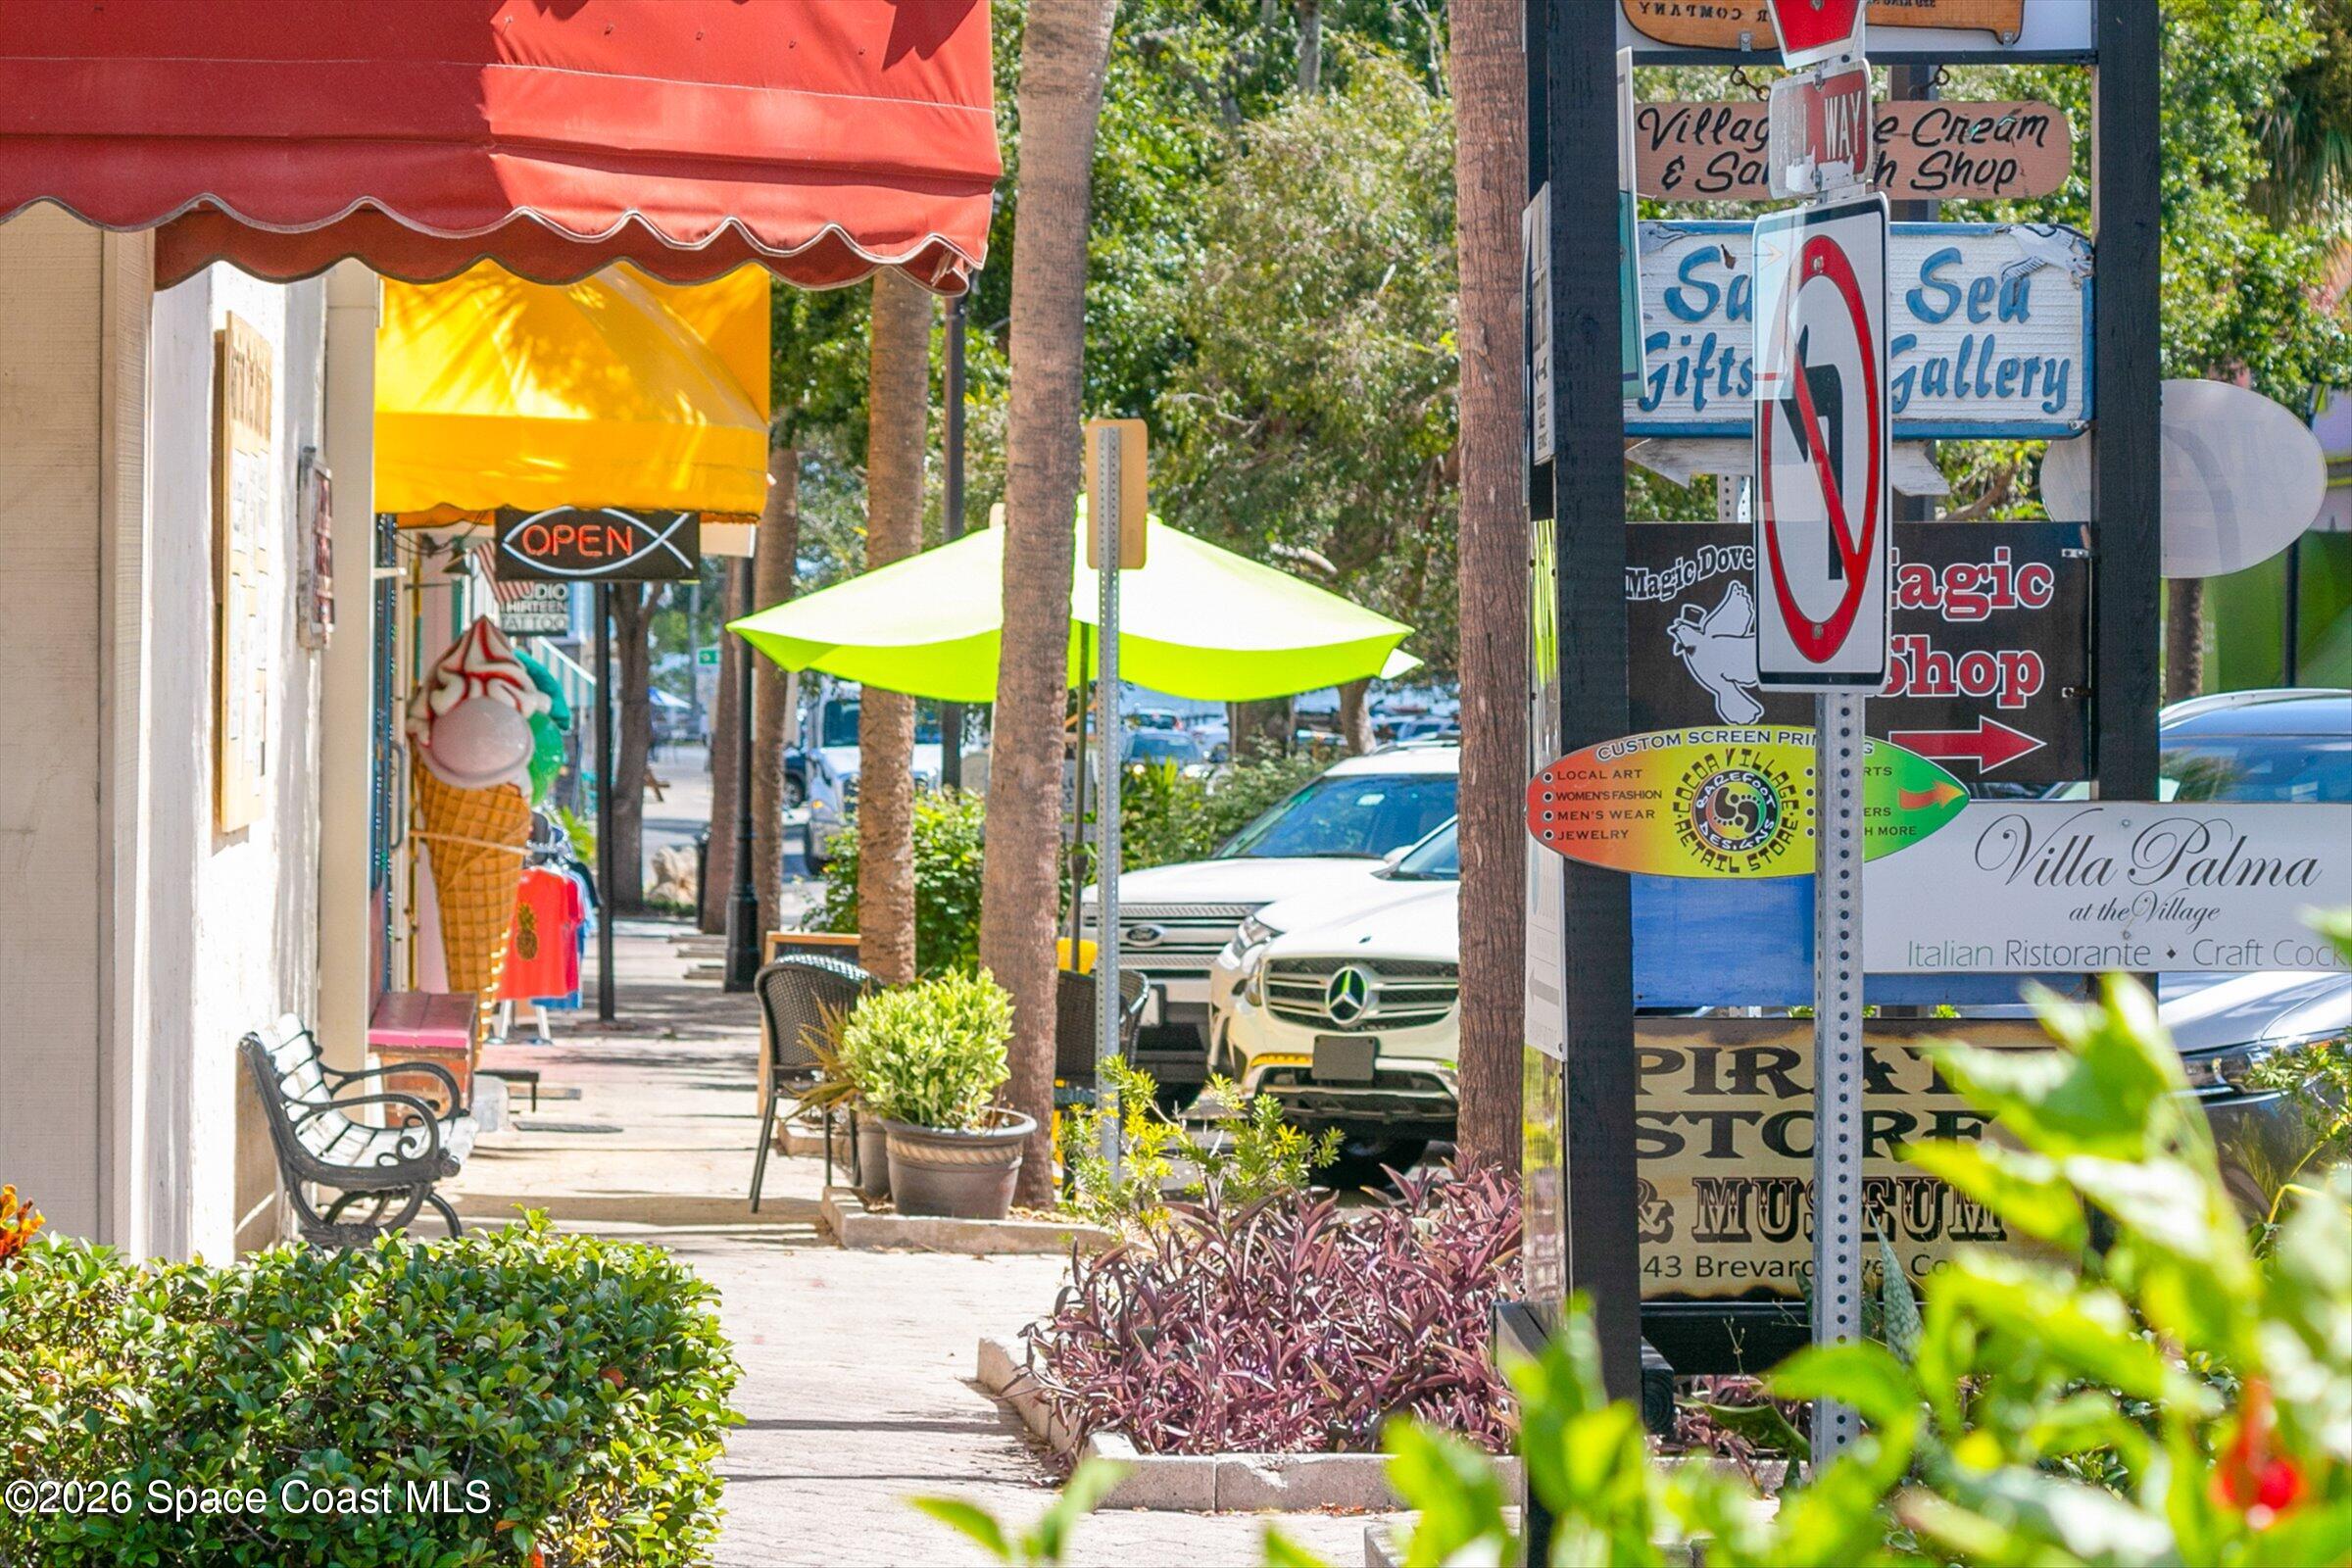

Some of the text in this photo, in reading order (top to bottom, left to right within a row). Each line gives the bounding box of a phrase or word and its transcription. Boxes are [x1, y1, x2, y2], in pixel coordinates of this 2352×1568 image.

[1637, 107, 1770, 153] Villag
[1912, 107, 2049, 147] Cream
[1824, 90, 1862, 160] WAY
[1910, 150, 2017, 194] Shop
[1905, 248, 2031, 323] Sea
[1638, 330, 2070, 415] Gifts Gallery
[521, 524, 633, 557] OPEN
[1626, 557, 1696, 602] Magic
[1891, 546, 2054, 621] agic
[501, 614, 566, 630] TATTOO
[1597, 733, 1681, 760] CUSTOM
[1688, 730, 1771, 744] SCREEN
[1557, 769, 1642, 780] LOCAL ART
[1673, 748, 1799, 812] COCOA VILLAGE
[1696, 771, 1776, 808] BAREFOOT
[1556, 790, 1662, 801] WOMEN'S FASHION
[1557, 809, 1655, 820] MEN'S WEAR
[1557, 830, 1629, 841] JEWELRY
[1878, 826, 1917, 836] MORE
[1974, 808, 2323, 887] Villa Palma
[2069, 887, 2221, 934] at the Village
[1908, 939, 2348, 967] Italian Ristorante Craft Cock
[1691, 1176, 2007, 1244] MUEUM
[1640, 1255, 1682, 1278] 43
